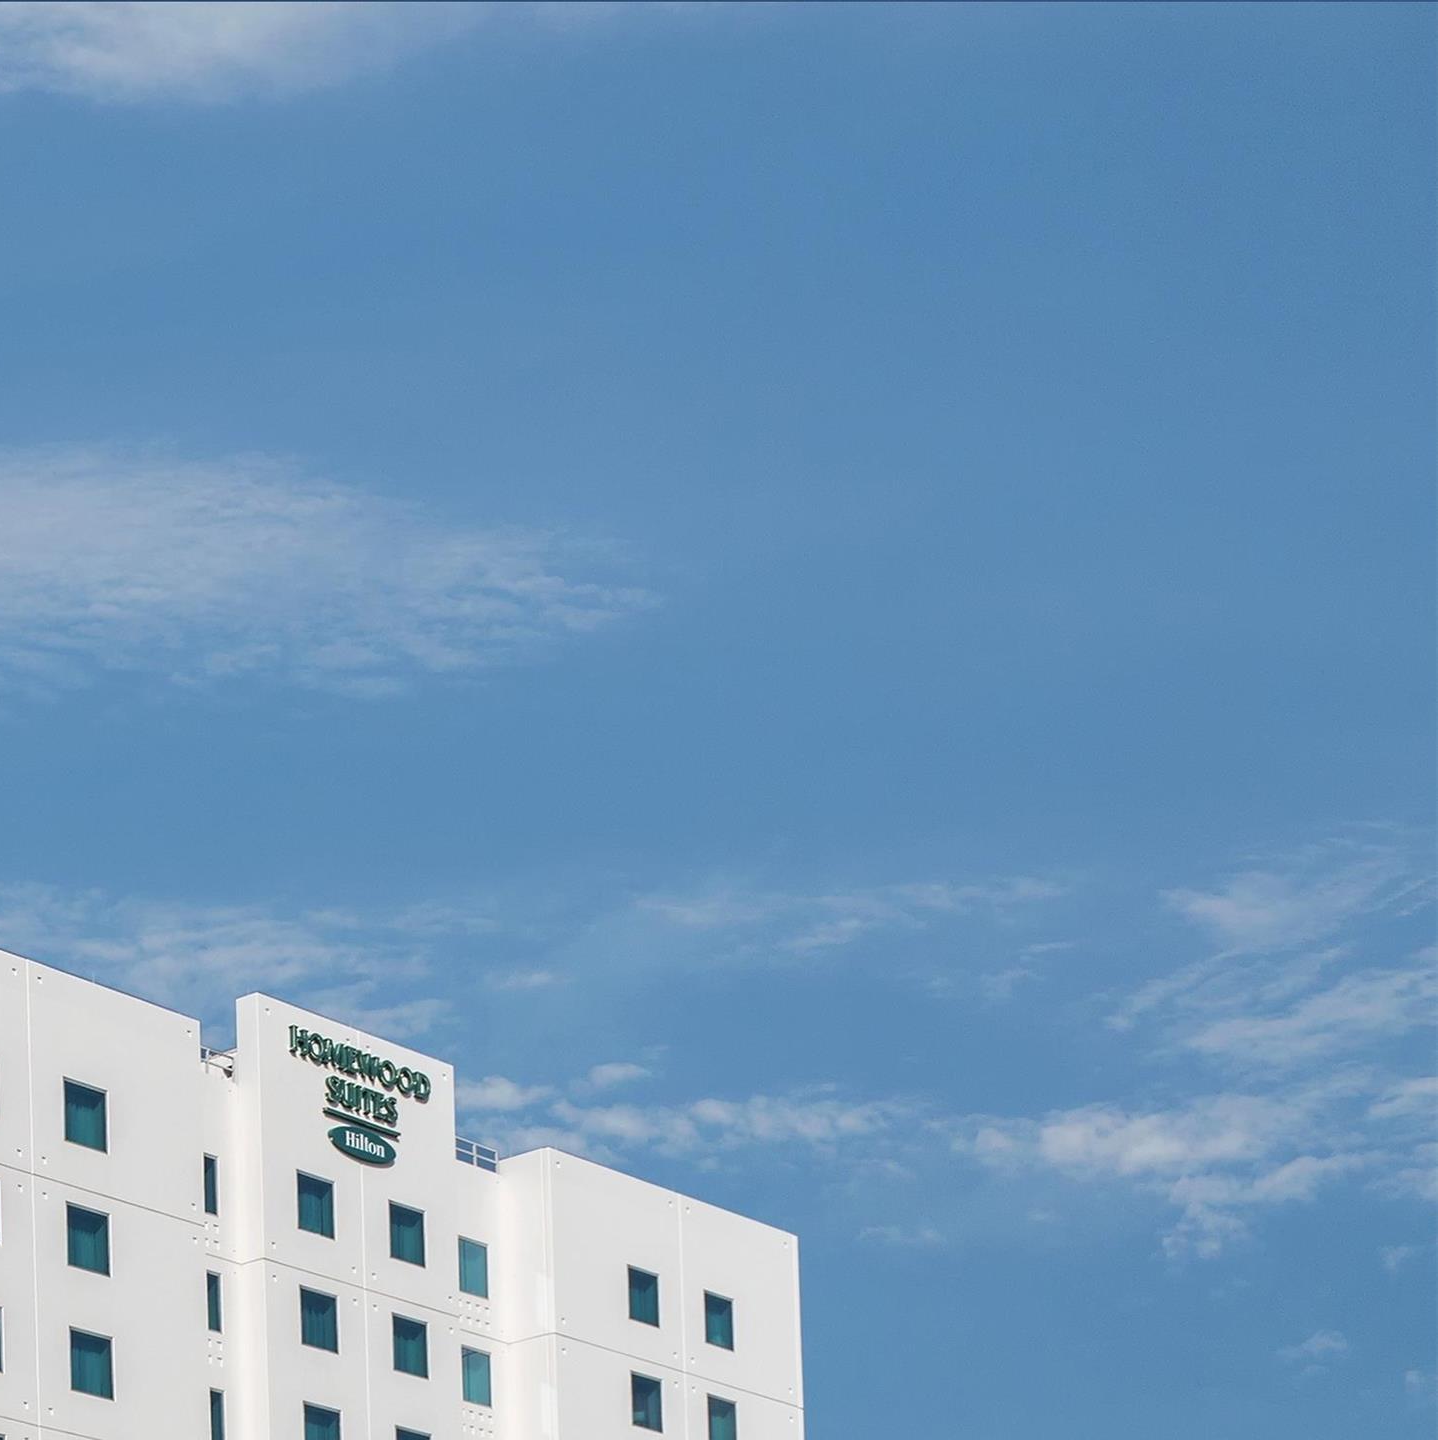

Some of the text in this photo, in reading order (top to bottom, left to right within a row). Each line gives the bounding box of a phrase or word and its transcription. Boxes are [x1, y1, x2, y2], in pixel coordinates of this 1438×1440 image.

[288, 1024, 432, 1102] HOMEWOOD
[325, 1075, 399, 1124] SUITES
[344, 1130, 385, 1158] Hilton
